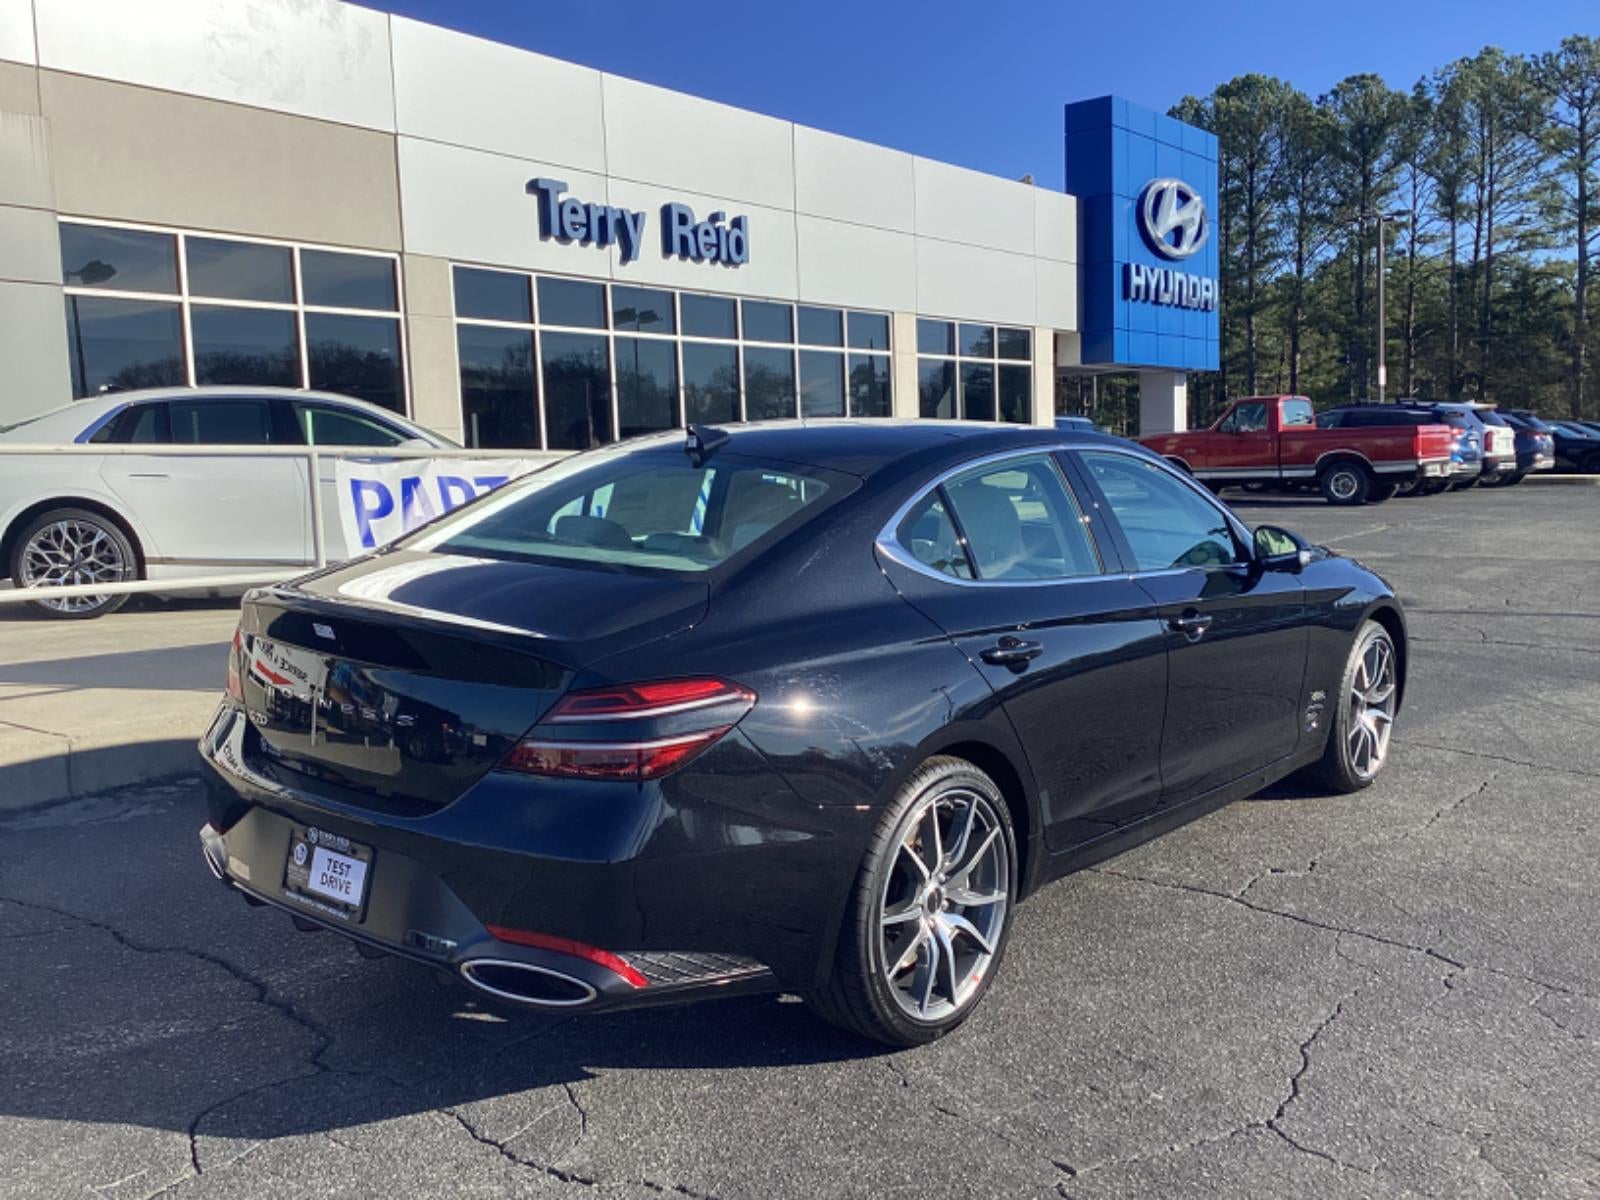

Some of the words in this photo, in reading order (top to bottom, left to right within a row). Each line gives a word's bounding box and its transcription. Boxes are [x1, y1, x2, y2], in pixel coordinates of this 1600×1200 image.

[526, 177, 646, 265] Terry
[660, 202, 750, 268] Reid
[1122, 263, 1219, 312] HYUNDAI
[320, 872, 352, 895] DRIVE
[327, 858, 352, 877] TEST
